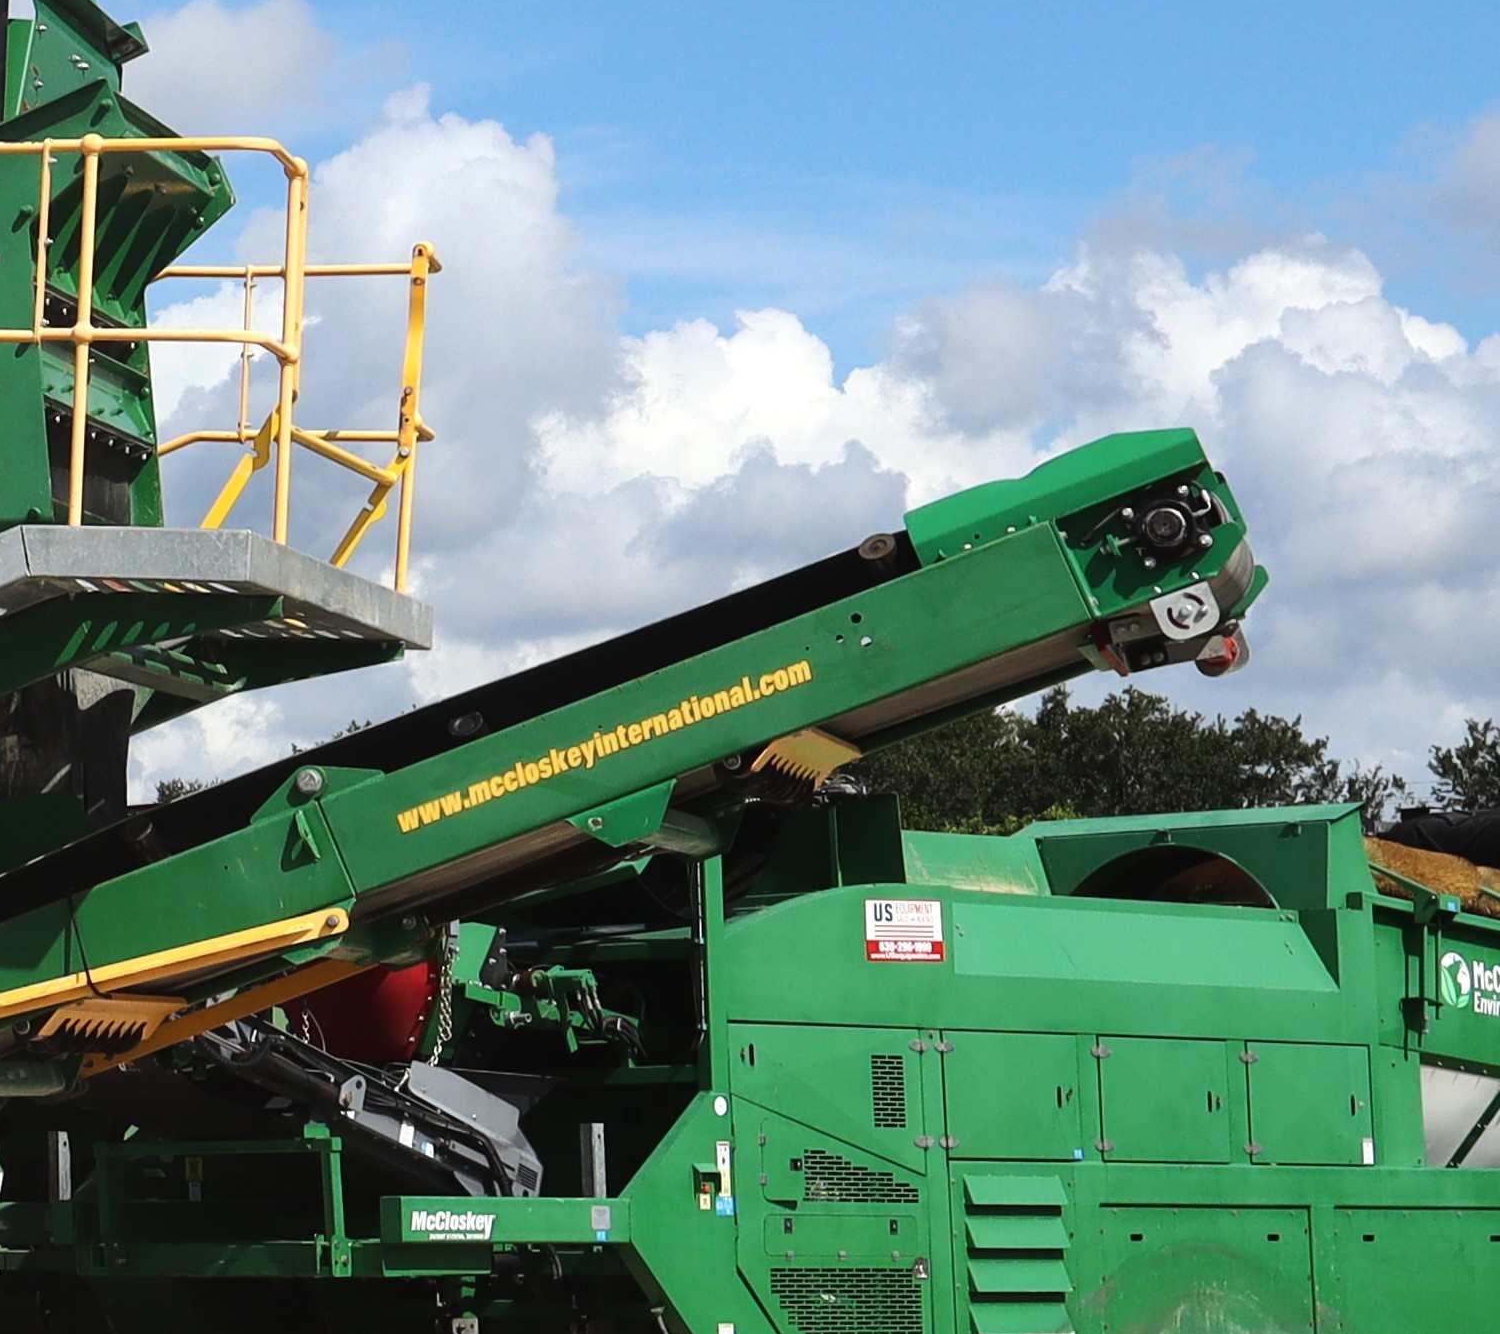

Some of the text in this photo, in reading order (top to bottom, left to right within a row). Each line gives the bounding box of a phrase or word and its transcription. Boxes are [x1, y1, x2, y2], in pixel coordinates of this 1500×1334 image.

[396, 659, 813, 834] www.mccloskeyinternational.com
[873, 903, 893, 922] US
[410, 1210, 497, 1241] McCloskey
